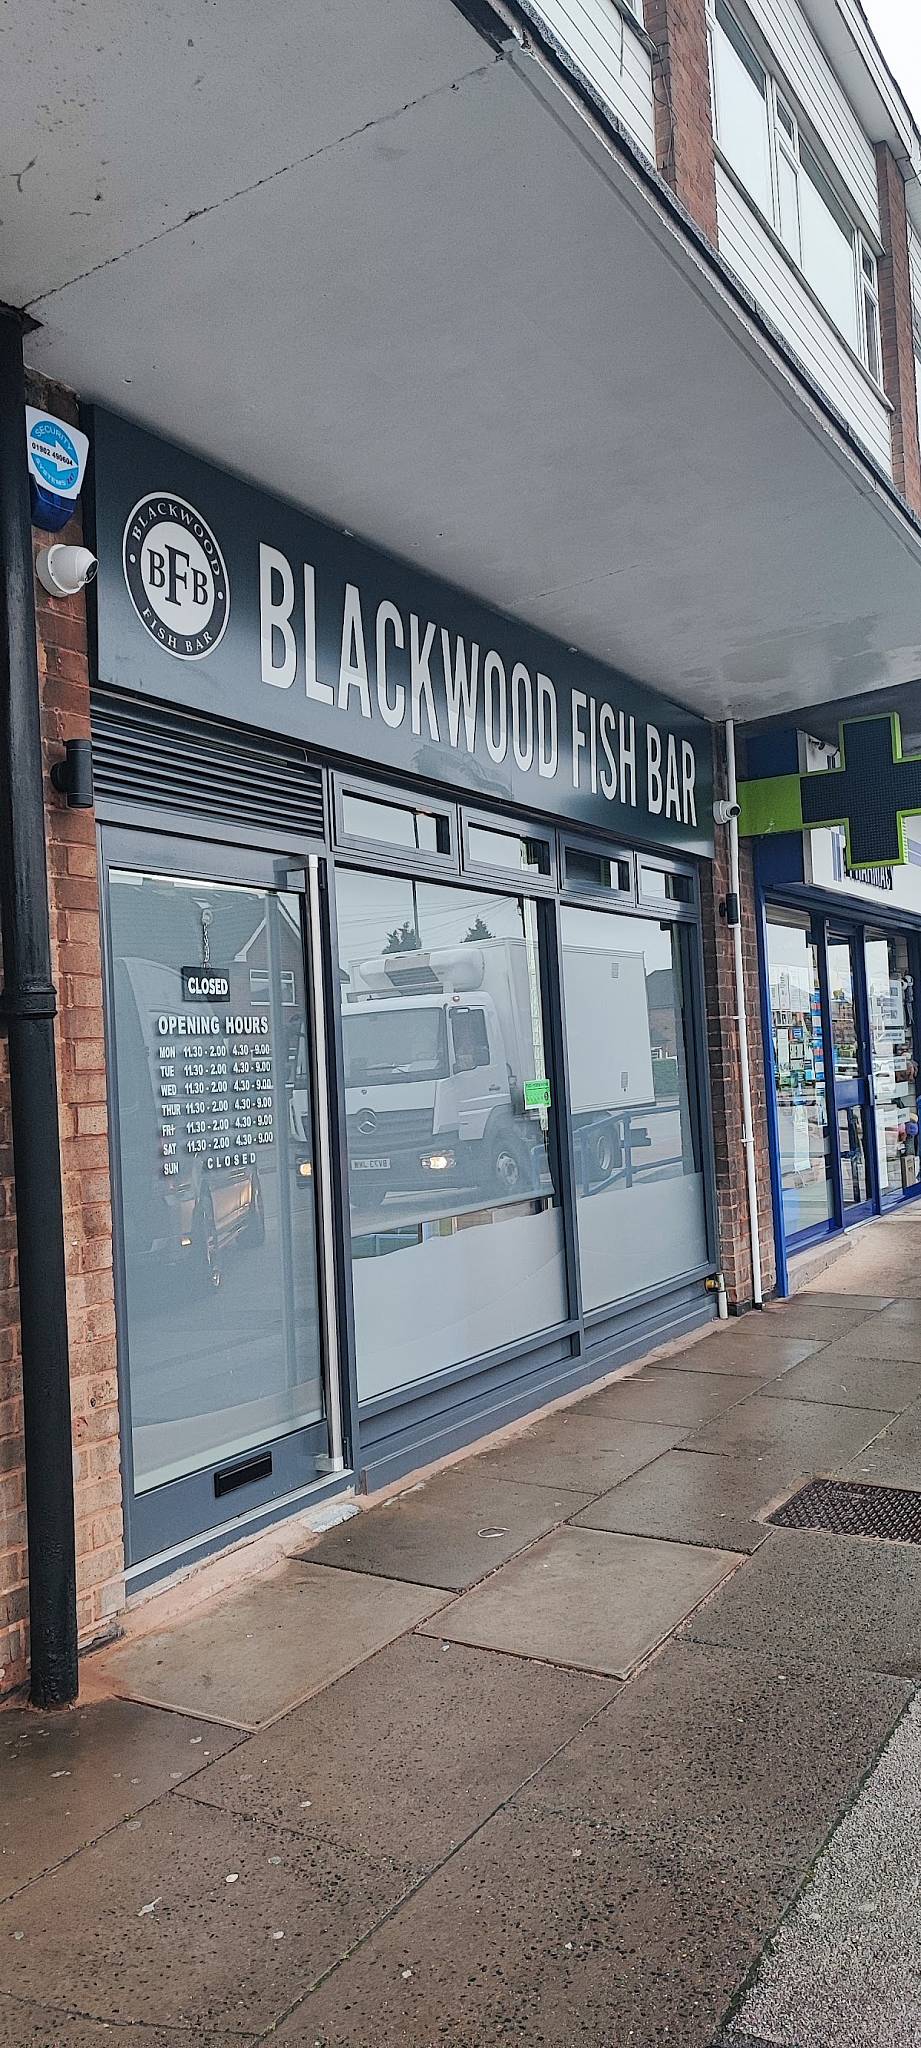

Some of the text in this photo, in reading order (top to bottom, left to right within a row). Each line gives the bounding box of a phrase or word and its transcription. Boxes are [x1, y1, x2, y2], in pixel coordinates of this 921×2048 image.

[35, 425, 73, 451] SECURITY
[132, 502, 220, 576] BLACKWOOD
[147, 544, 209, 606] BFB
[142, 608, 213, 652] FISH BAR
[259, 541, 698, 827] BLACKWOOD FISH BAR
[187, 977, 229, 995] CLOSED
[158, 1015, 269, 1034] OPENING HOURS
[159, 1046, 176, 1058] MON
[183, 1046, 203, 1057] 11.30
[209, 1045, 226, 1057] 2.00
[232, 1044, 249, 1056] 4.30
[254, 1043, 270, 1055] 9.00
[160, 1065, 175, 1077] TUE
[184, 1064, 204, 1076] 11.30
[210, 1063, 227, 1075] 2.00
[233, 1062, 249, 1073] 4.30
[255, 1061, 271, 1072] 9.00
[160, 1084, 177, 1097] WED
[184, 1082, 204, 1094] 11.30
[211, 1081, 228, 1093] 2.00
[233, 1079, 250, 1091] 4.30
[256, 1078, 272, 1090] 9.00
[161, 1104, 181, 1116] THUR
[185, 1102, 205, 1114] 11.30
[211, 1100, 228, 1113] 2.00
[234, 1098, 251, 1110] 4.30
[256, 1096, 272, 1108] 9.00
[186, 1121, 206, 1134] 11.30
[212, 1118, 229, 1131] 2.00
[235, 1116, 251, 1128] 4.30
[257, 1114, 273, 1126] 9.00
[163, 1143, 177, 1156] SAT
[186, 1139, 206, 1152] 11.30
[213, 1137, 230, 1150] 2.00
[235, 1134, 252, 1146] 4.30
[258, 1131, 274, 1144] 9.00
[164, 1152, 256, 1175] SUN CLOSED
